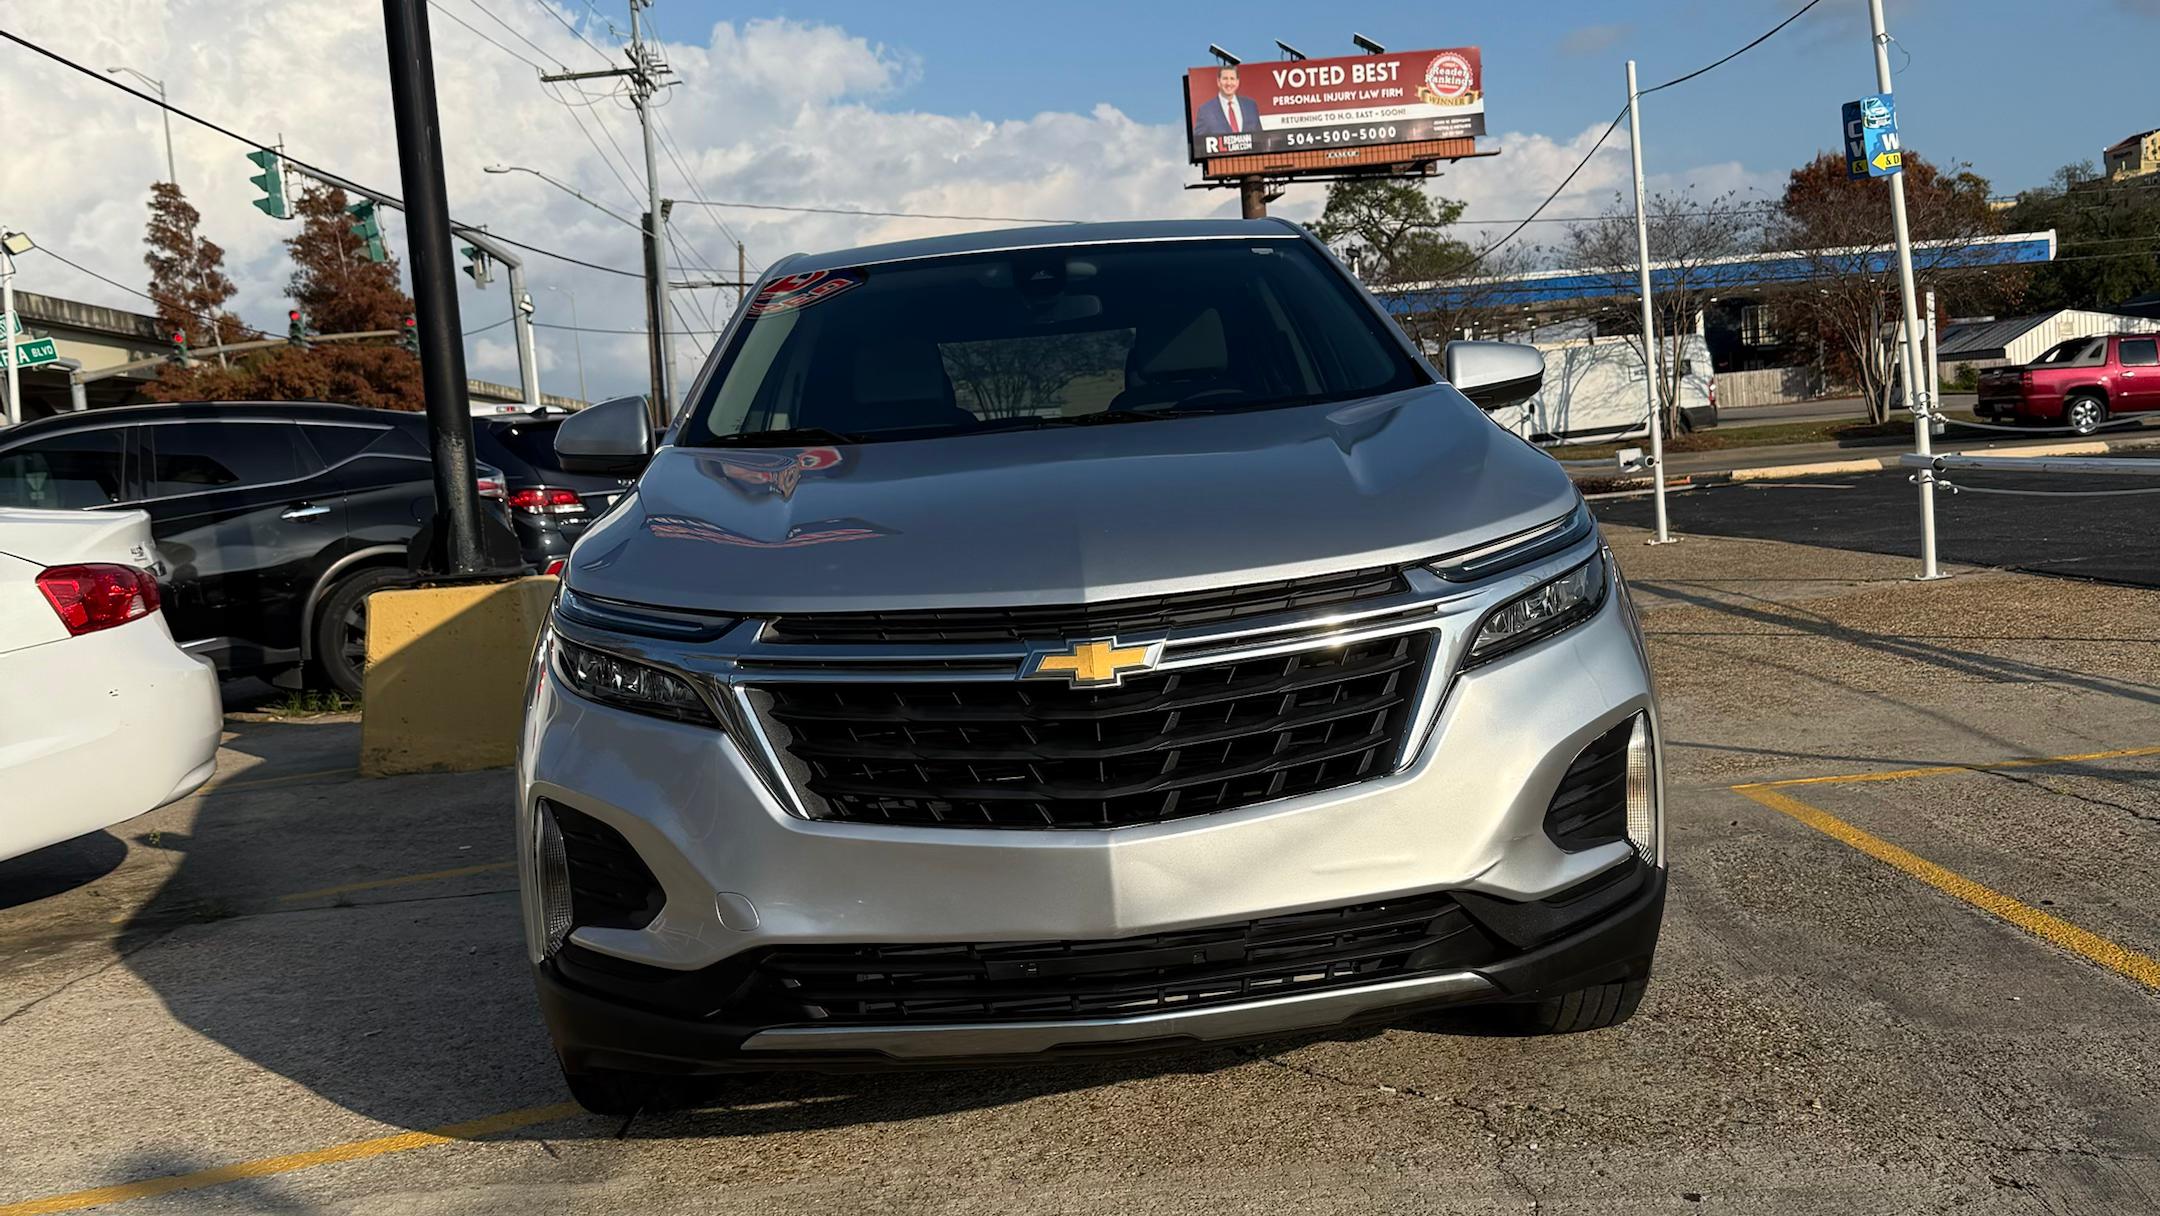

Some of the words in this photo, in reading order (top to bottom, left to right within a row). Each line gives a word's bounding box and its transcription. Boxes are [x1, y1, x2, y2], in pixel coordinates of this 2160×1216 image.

[1272, 65, 1345, 89] VOTED
[1352, 61, 1400, 84] BEST
[1272, 93, 1321, 106] PERSONAL
[1323, 91, 1356, 102] INJURY
[1359, 89, 1379, 100] LAW
[1381, 87, 1403, 99] FIRM
[1281, 113, 1323, 124] RETURNING
[1325, 113, 1336, 121] TO
[1356, 110, 1373, 118] EAST
[1381, 108, 1406, 118] SOON!
[1287, 125, 1397, 146] 504-500-5000
[31, 345, 54, 358] BLVD
